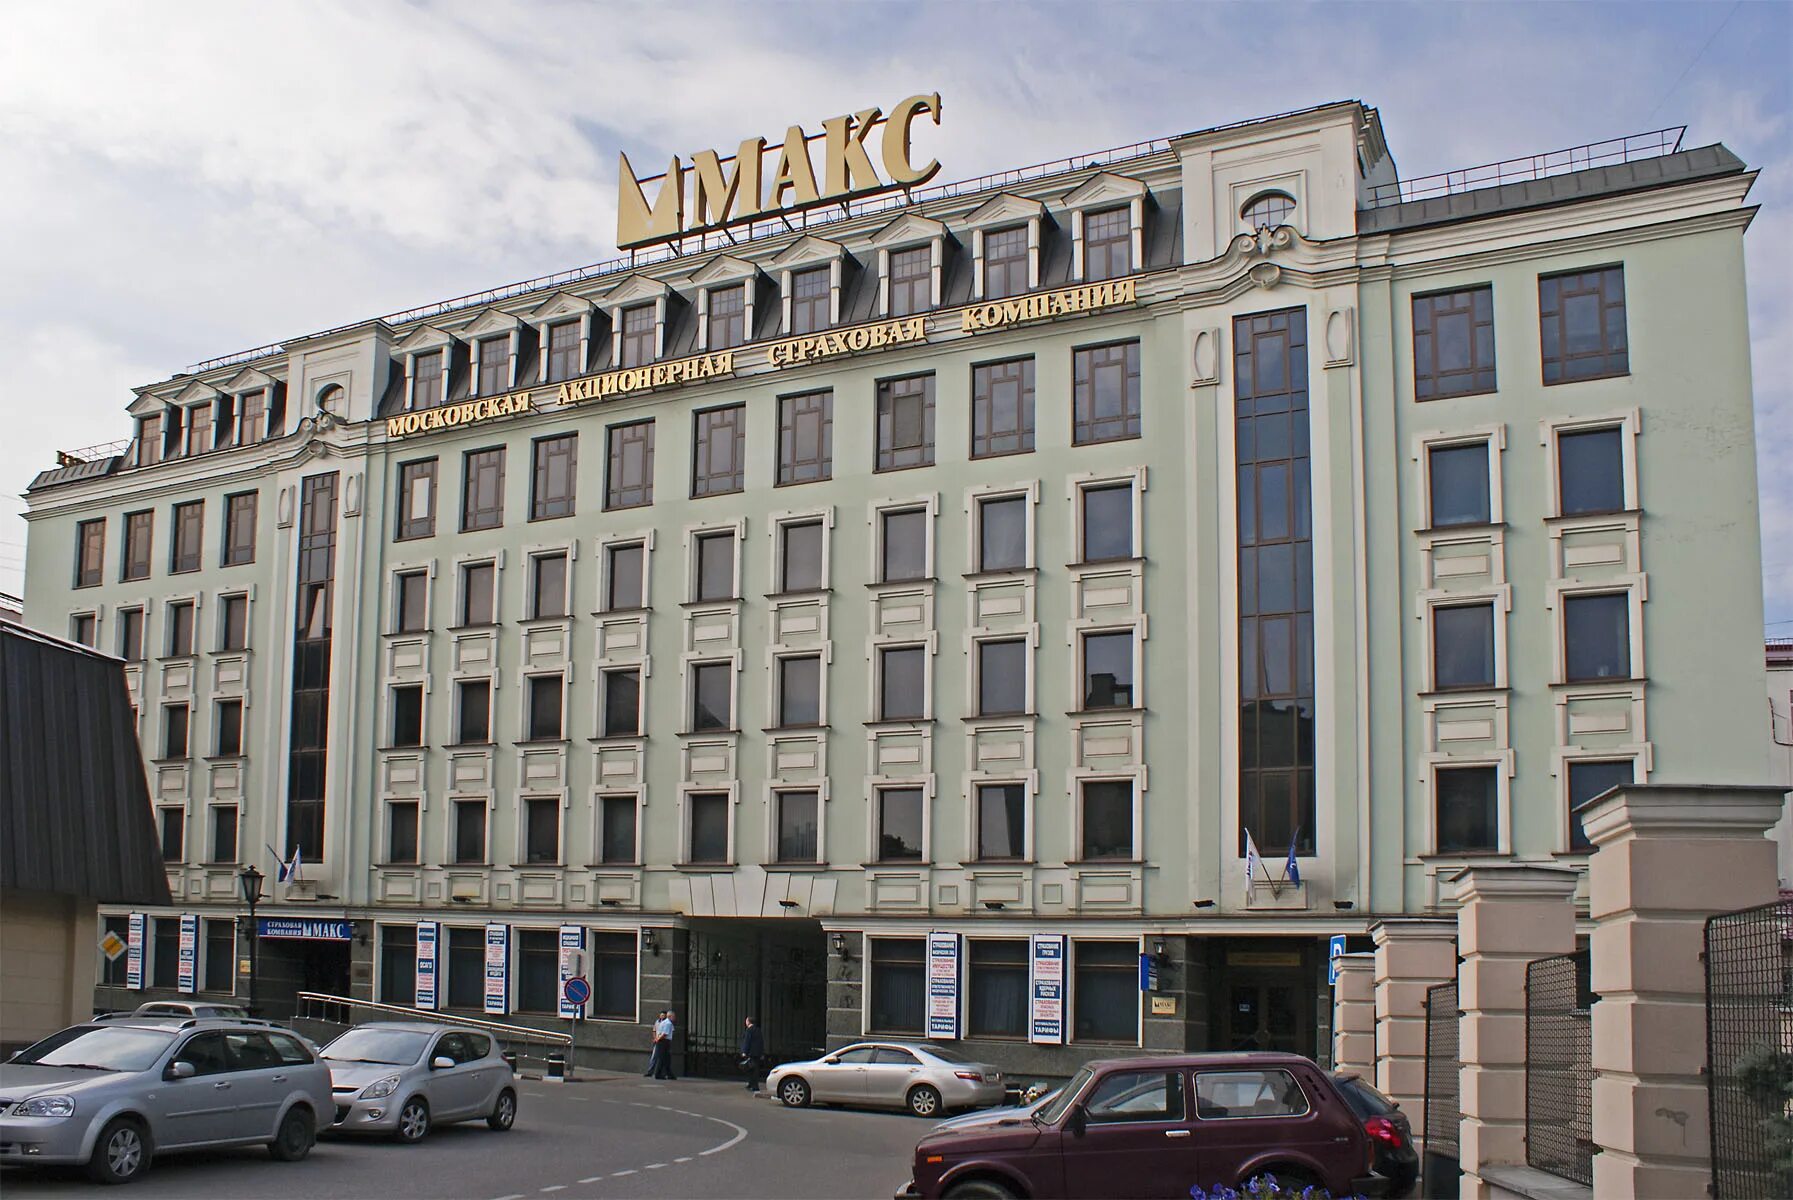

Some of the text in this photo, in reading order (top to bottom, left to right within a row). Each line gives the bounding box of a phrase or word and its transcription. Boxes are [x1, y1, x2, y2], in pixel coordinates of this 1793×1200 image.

[689, 91, 943, 229] МАКС
[388, 280, 1138, 437] МОСКОВСКАЯ АКЦИОНЕРНАЯ СТРАХОВАЯ КОМПАНИЯ
[267, 921, 302, 929] СТРАХОВАЯ
[312, 923, 344, 938] МАКС
[1034, 1026, 1059, 1034] ТАРИФЫ
